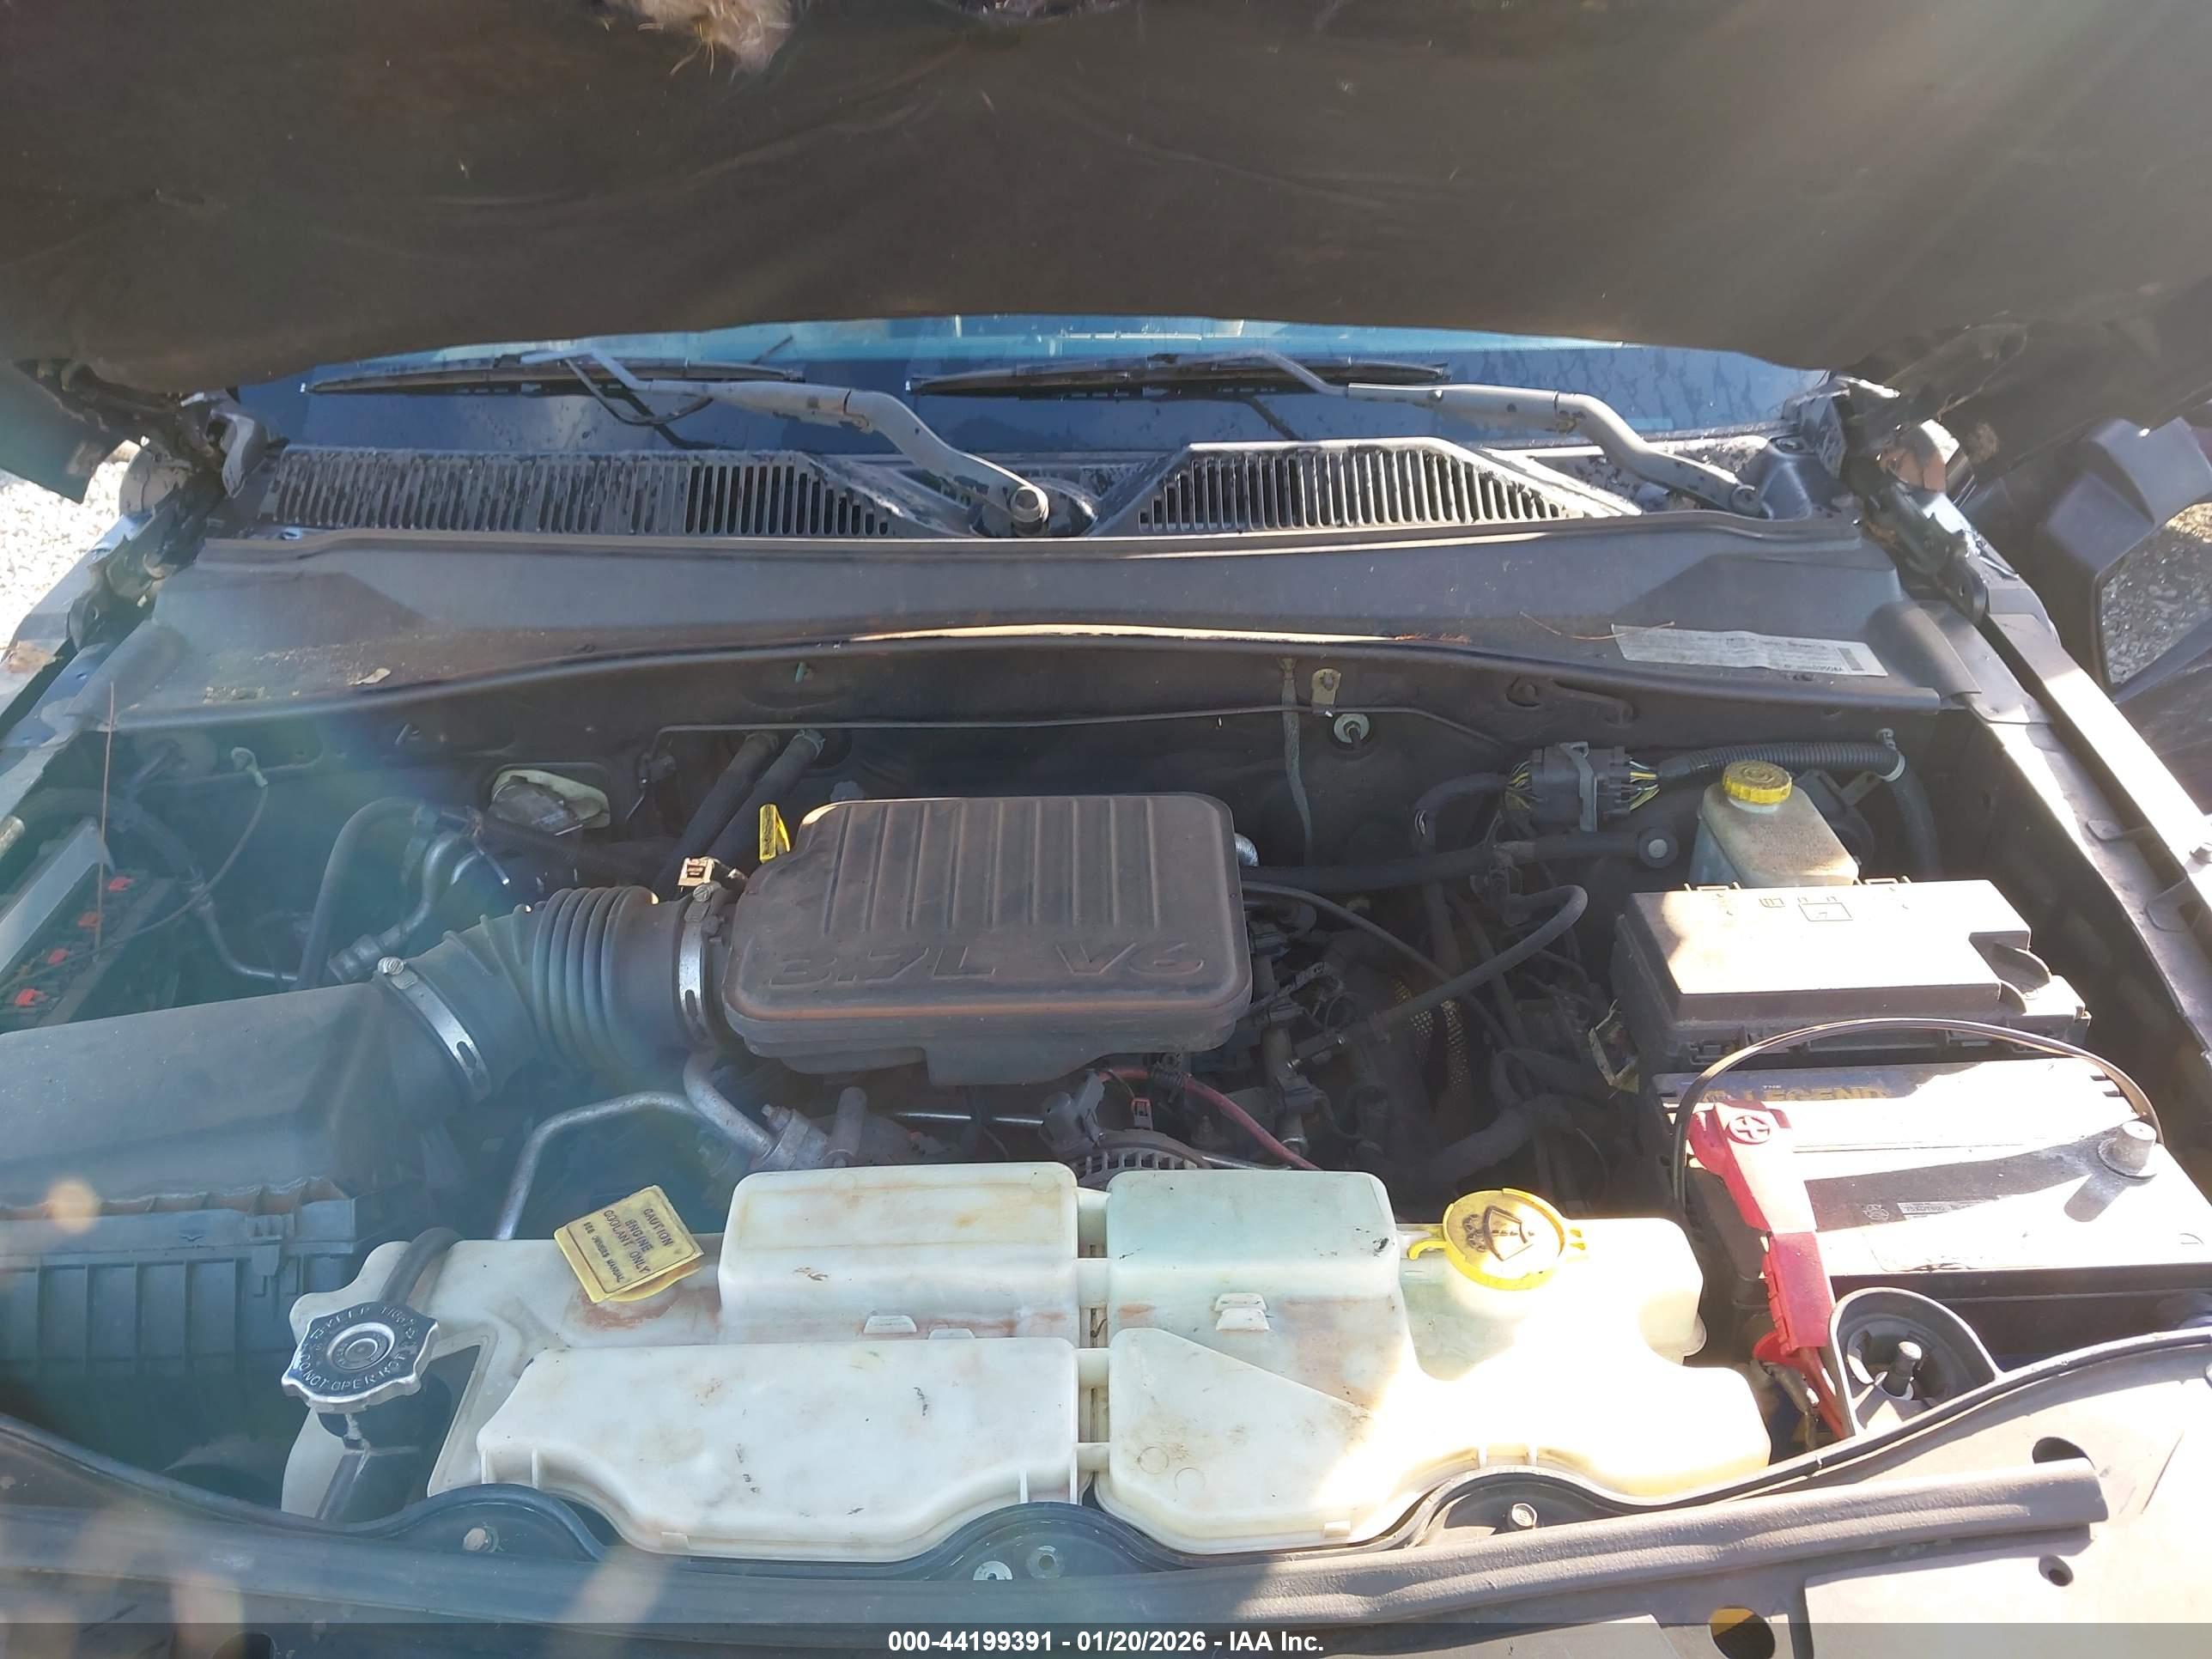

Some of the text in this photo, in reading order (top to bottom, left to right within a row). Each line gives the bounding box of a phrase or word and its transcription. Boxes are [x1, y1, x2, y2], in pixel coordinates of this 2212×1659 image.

[769, 942, 1206, 988] 3.7L V6
[604, 1209, 652, 1274] COOLANT ONLY
[624, 1218, 653, 1253] ENGINE
[643, 1208, 674, 1248] CAUTION
[606, 1259, 626, 1283] MANUAL
[299, 1352, 311, 1372] DO
[303, 1371, 330, 1388] NOT
